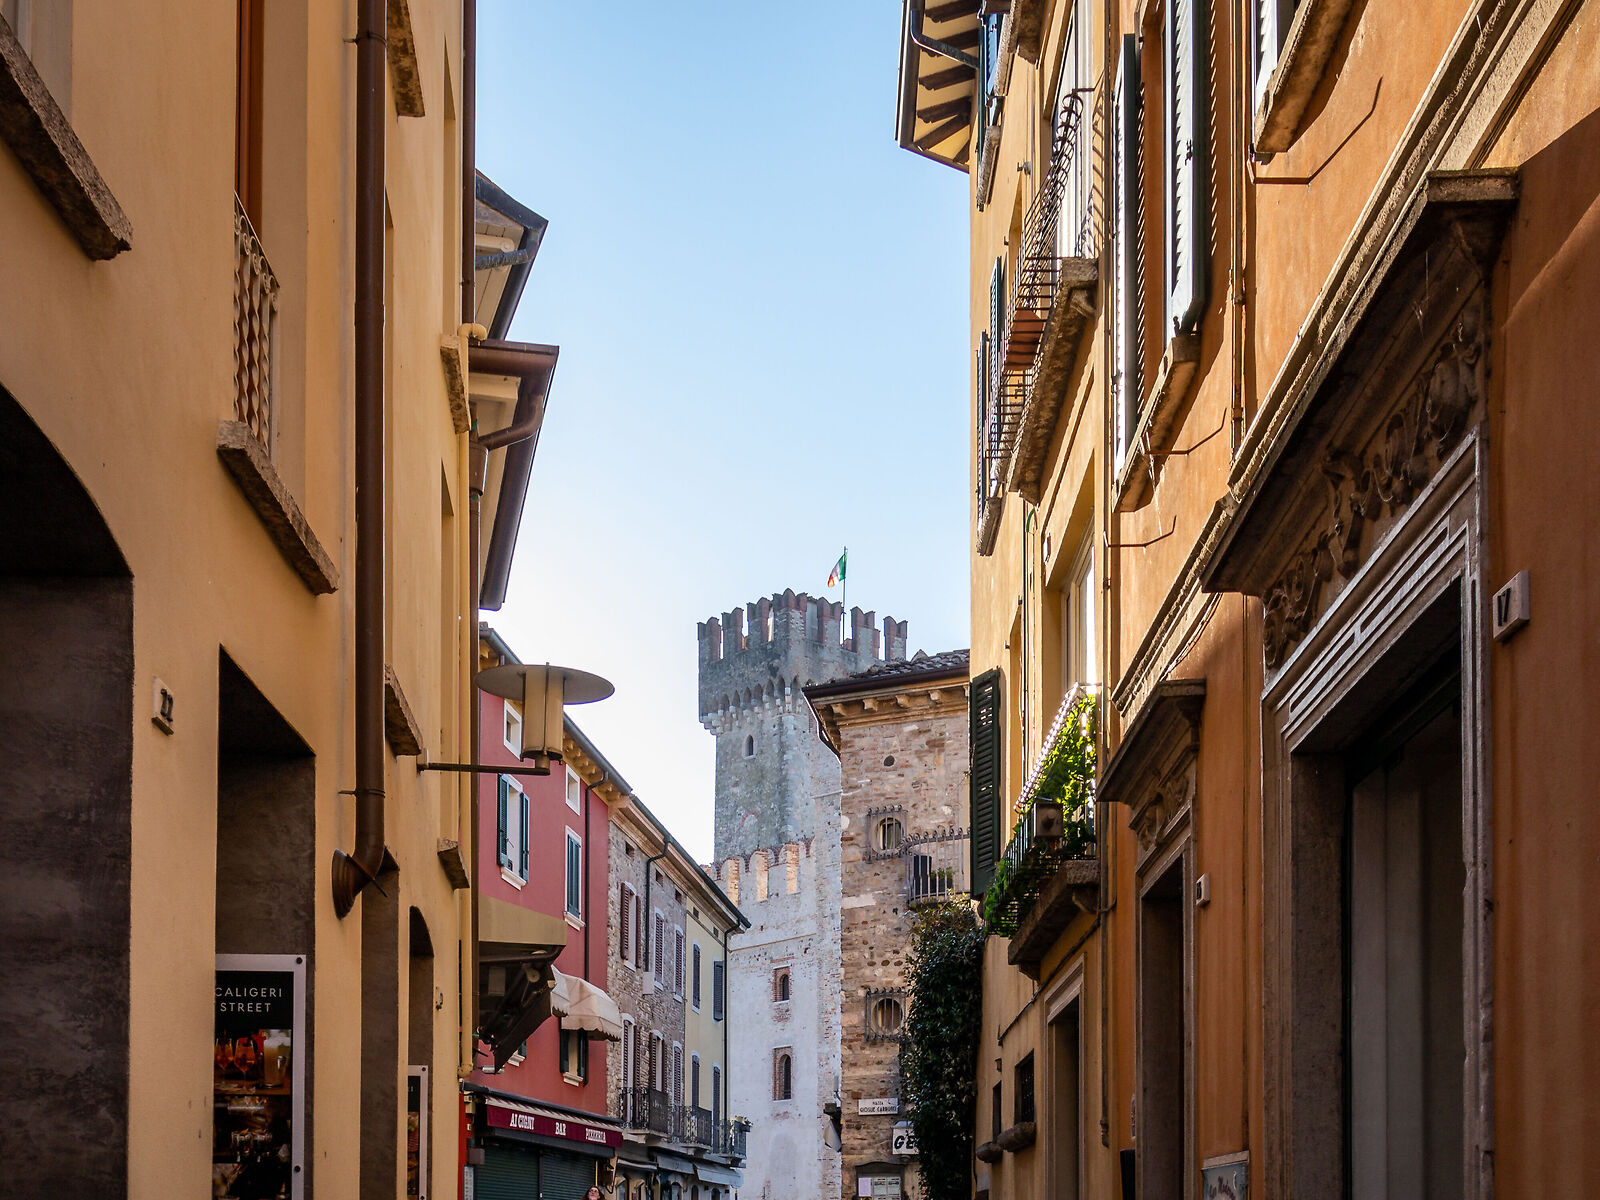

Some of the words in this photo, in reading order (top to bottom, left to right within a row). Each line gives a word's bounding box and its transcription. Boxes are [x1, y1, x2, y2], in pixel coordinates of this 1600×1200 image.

[1497, 588, 1511, 626] 17
[220, 1002, 271, 1013] STREET
[555, 1122, 567, 1136] BAR
[585, 1128, 607, 1144] PIZZERIA
